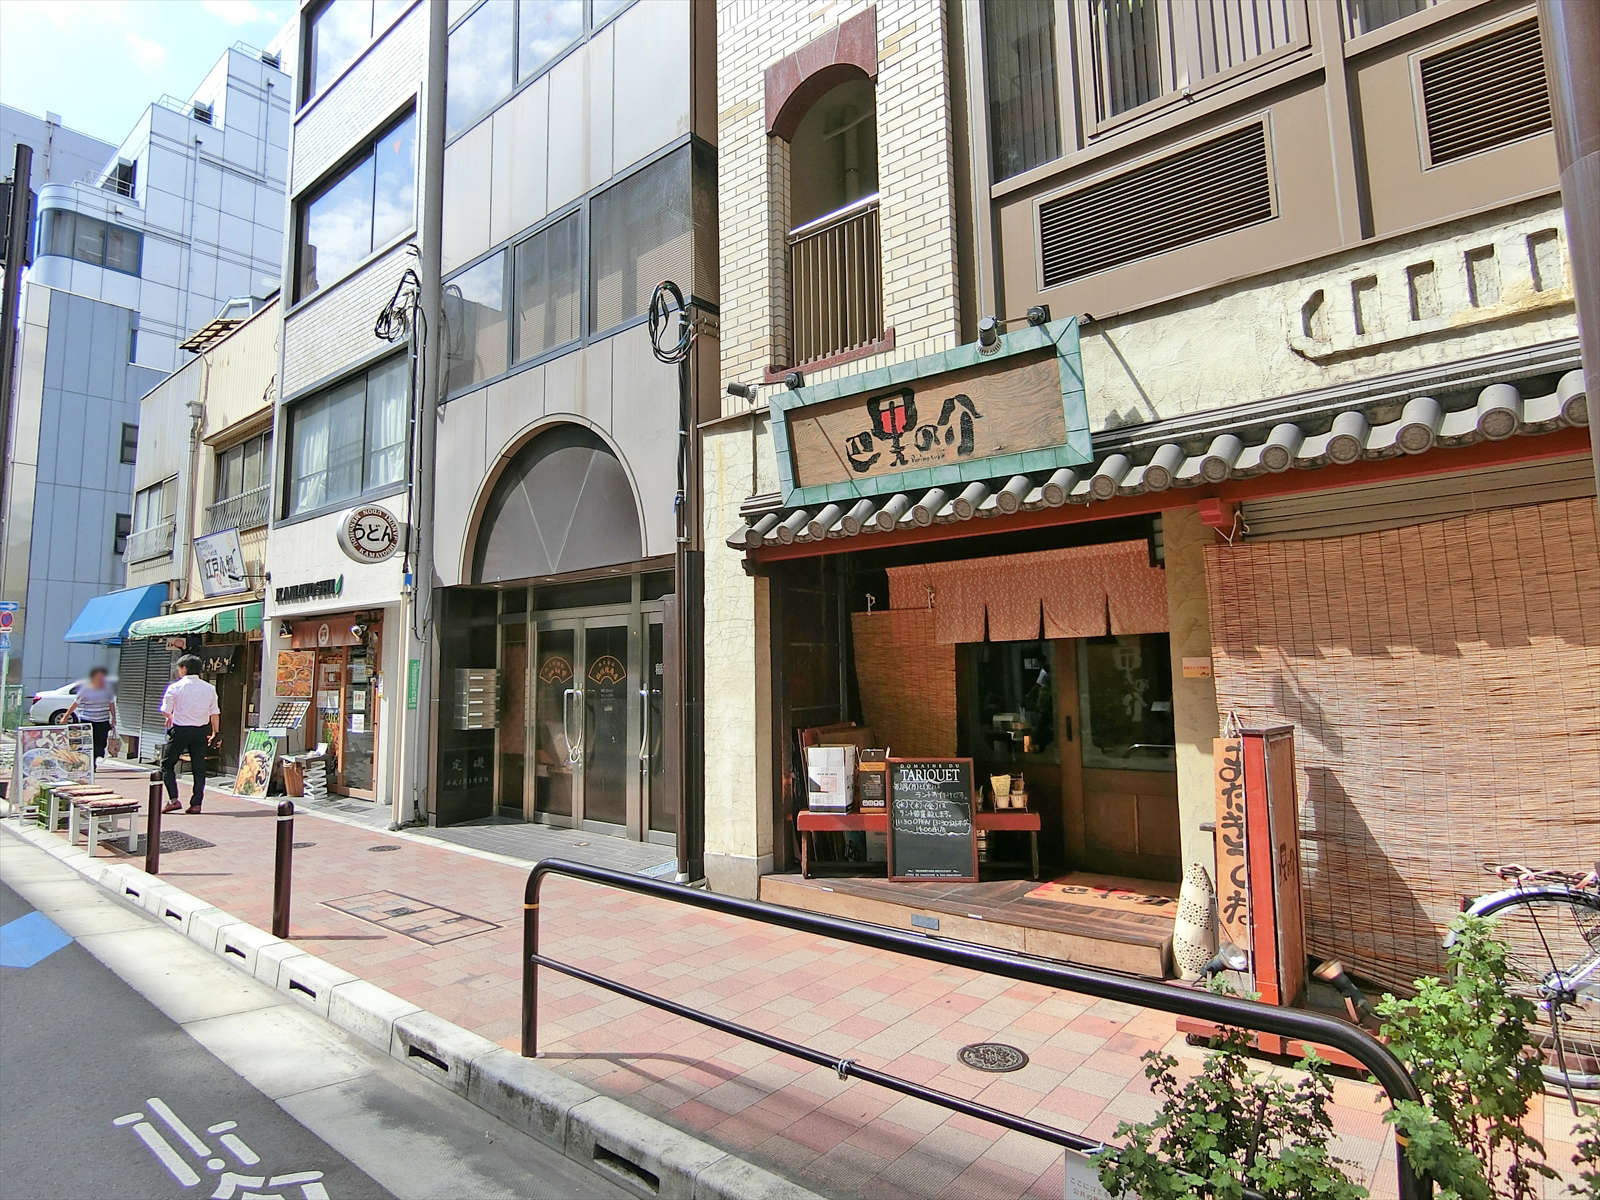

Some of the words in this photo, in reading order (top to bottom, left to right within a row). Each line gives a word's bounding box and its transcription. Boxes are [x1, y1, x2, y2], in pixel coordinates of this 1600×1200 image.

[362, 508, 382, 516] UDON
[353, 523, 395, 543] うどん
[358, 542, 396, 558] KAMAYOSHI
[275, 578, 336, 602] KAMAYOSHI
[324, 712, 340, 723] CURR
[900, 769, 960, 784] TARIQUET
